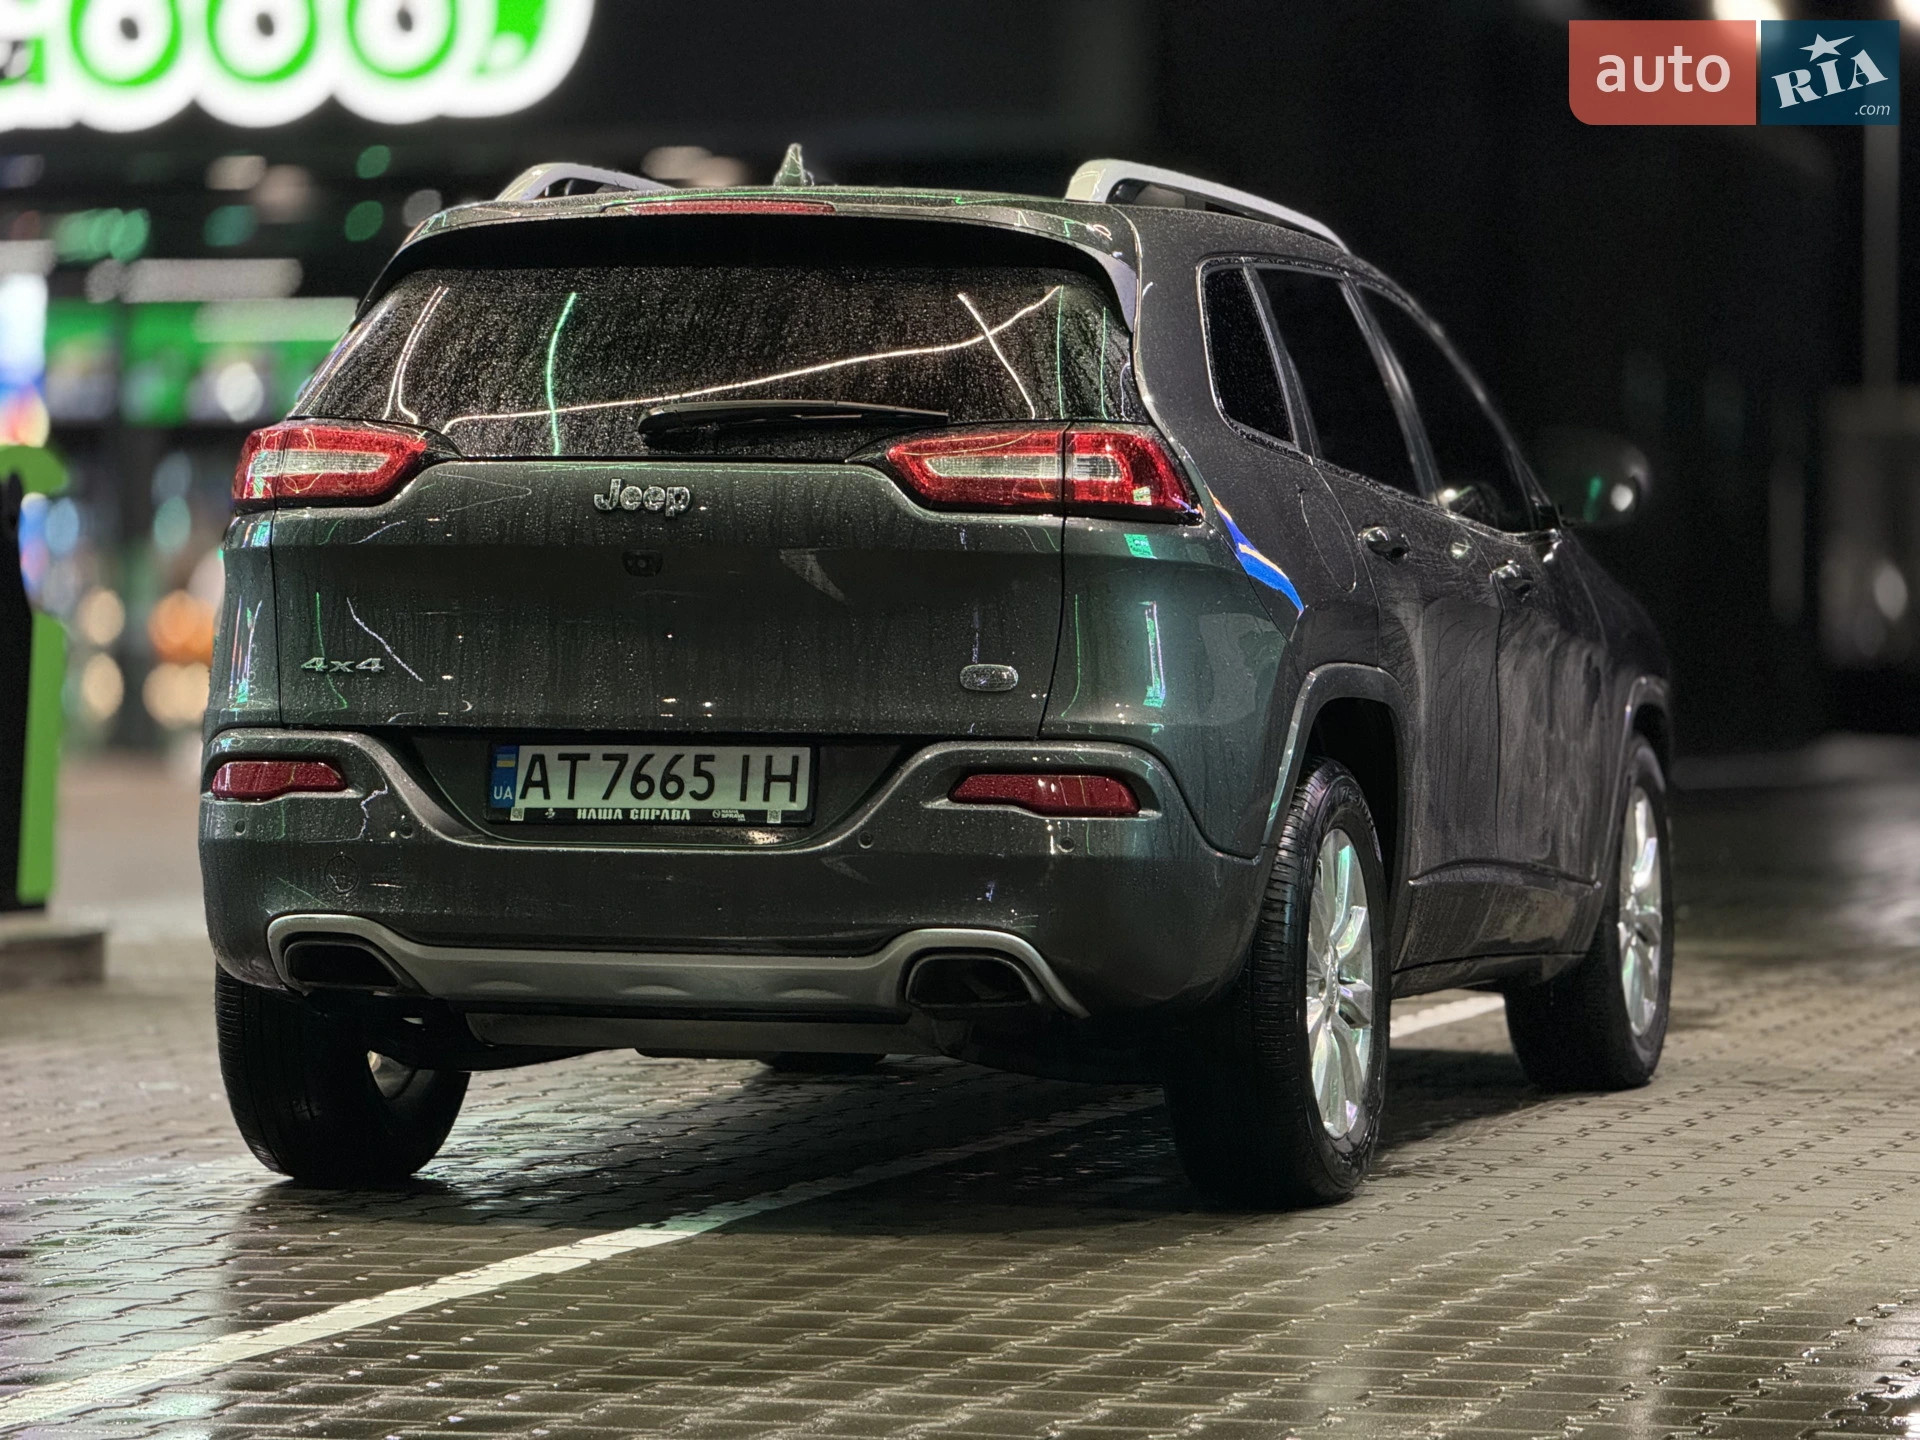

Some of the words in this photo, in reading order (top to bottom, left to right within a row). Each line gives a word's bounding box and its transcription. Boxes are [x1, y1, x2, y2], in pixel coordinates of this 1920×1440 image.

[593, 478, 691, 517] Jeep
[300, 656, 385, 673] 4x4
[518, 752, 591, 801] AT
[601, 752, 716, 801] 7665
[739, 754, 800, 803] IH
[493, 786, 513, 800] UA
[576, 808, 623, 820] НАША
[629, 808, 691, 820] СПРАВА
